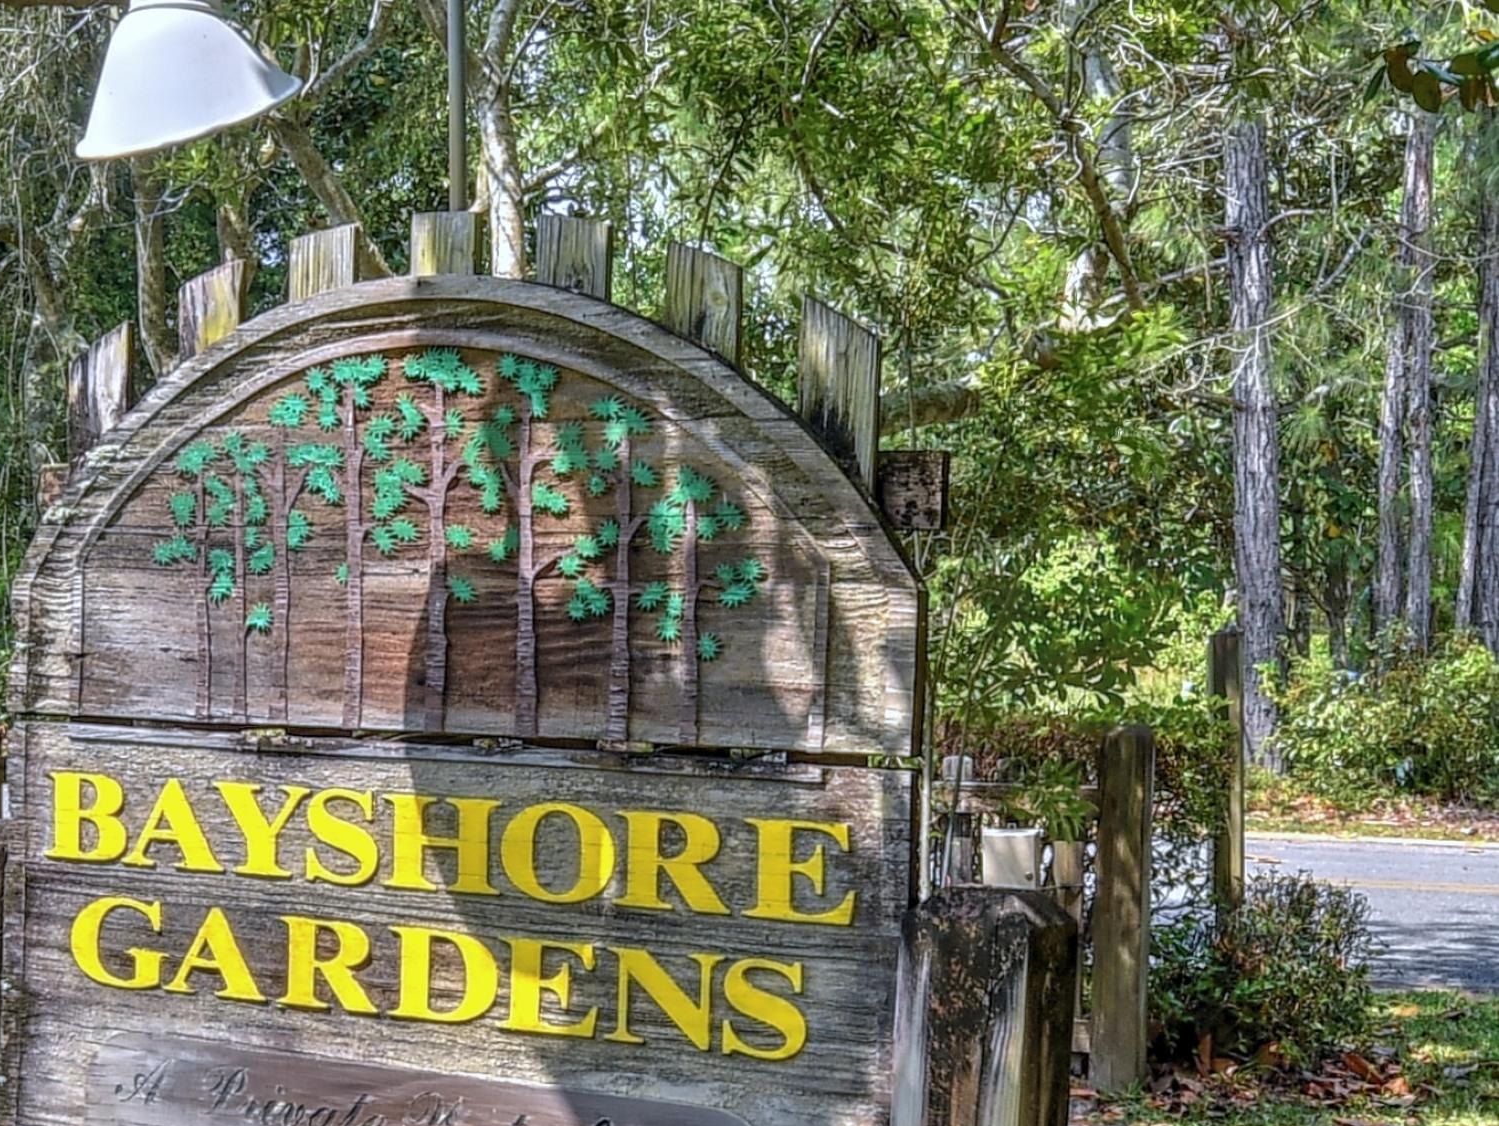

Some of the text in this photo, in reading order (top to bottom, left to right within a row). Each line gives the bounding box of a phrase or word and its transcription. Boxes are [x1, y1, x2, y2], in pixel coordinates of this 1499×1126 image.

[45, 770, 858, 926] BAYSHORE
[69, 896, 808, 1061] GARDENS
[114, 1061, 165, 1105] A
